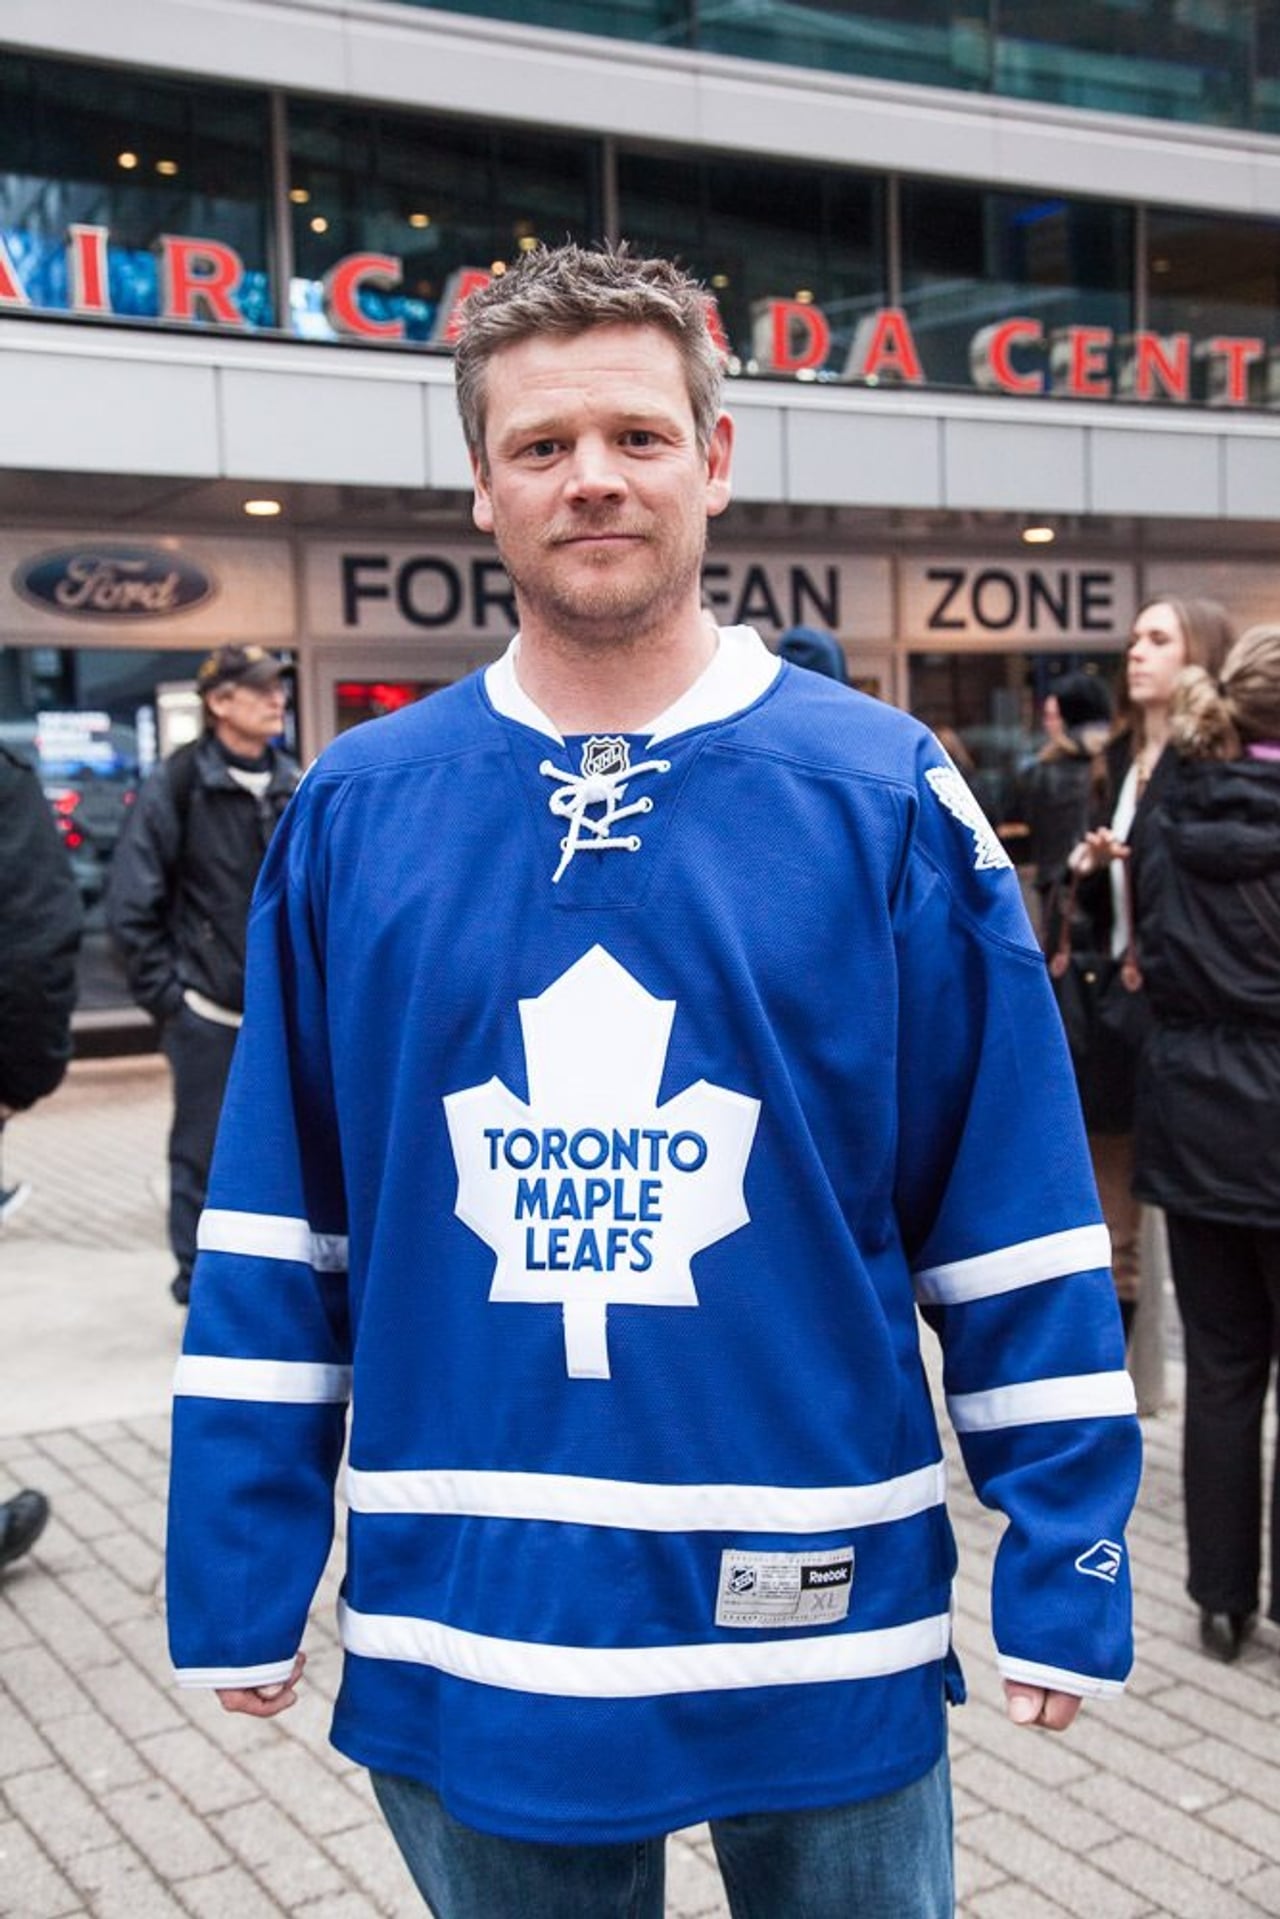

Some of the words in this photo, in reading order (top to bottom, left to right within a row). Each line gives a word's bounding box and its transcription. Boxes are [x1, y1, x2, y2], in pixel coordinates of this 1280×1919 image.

[55, 556, 179, 611] Ford
[926, 567, 1114, 631] ZONE
[592, 747, 621, 773] NHL
[483, 1128, 708, 1173] TORONTO
[514, 1177, 663, 1222] MAPLE
[525, 1227, 654, 1273] LEAFS
[809, 1567, 848, 1584] Reebok
[810, 1592, 839, 1611] XL
